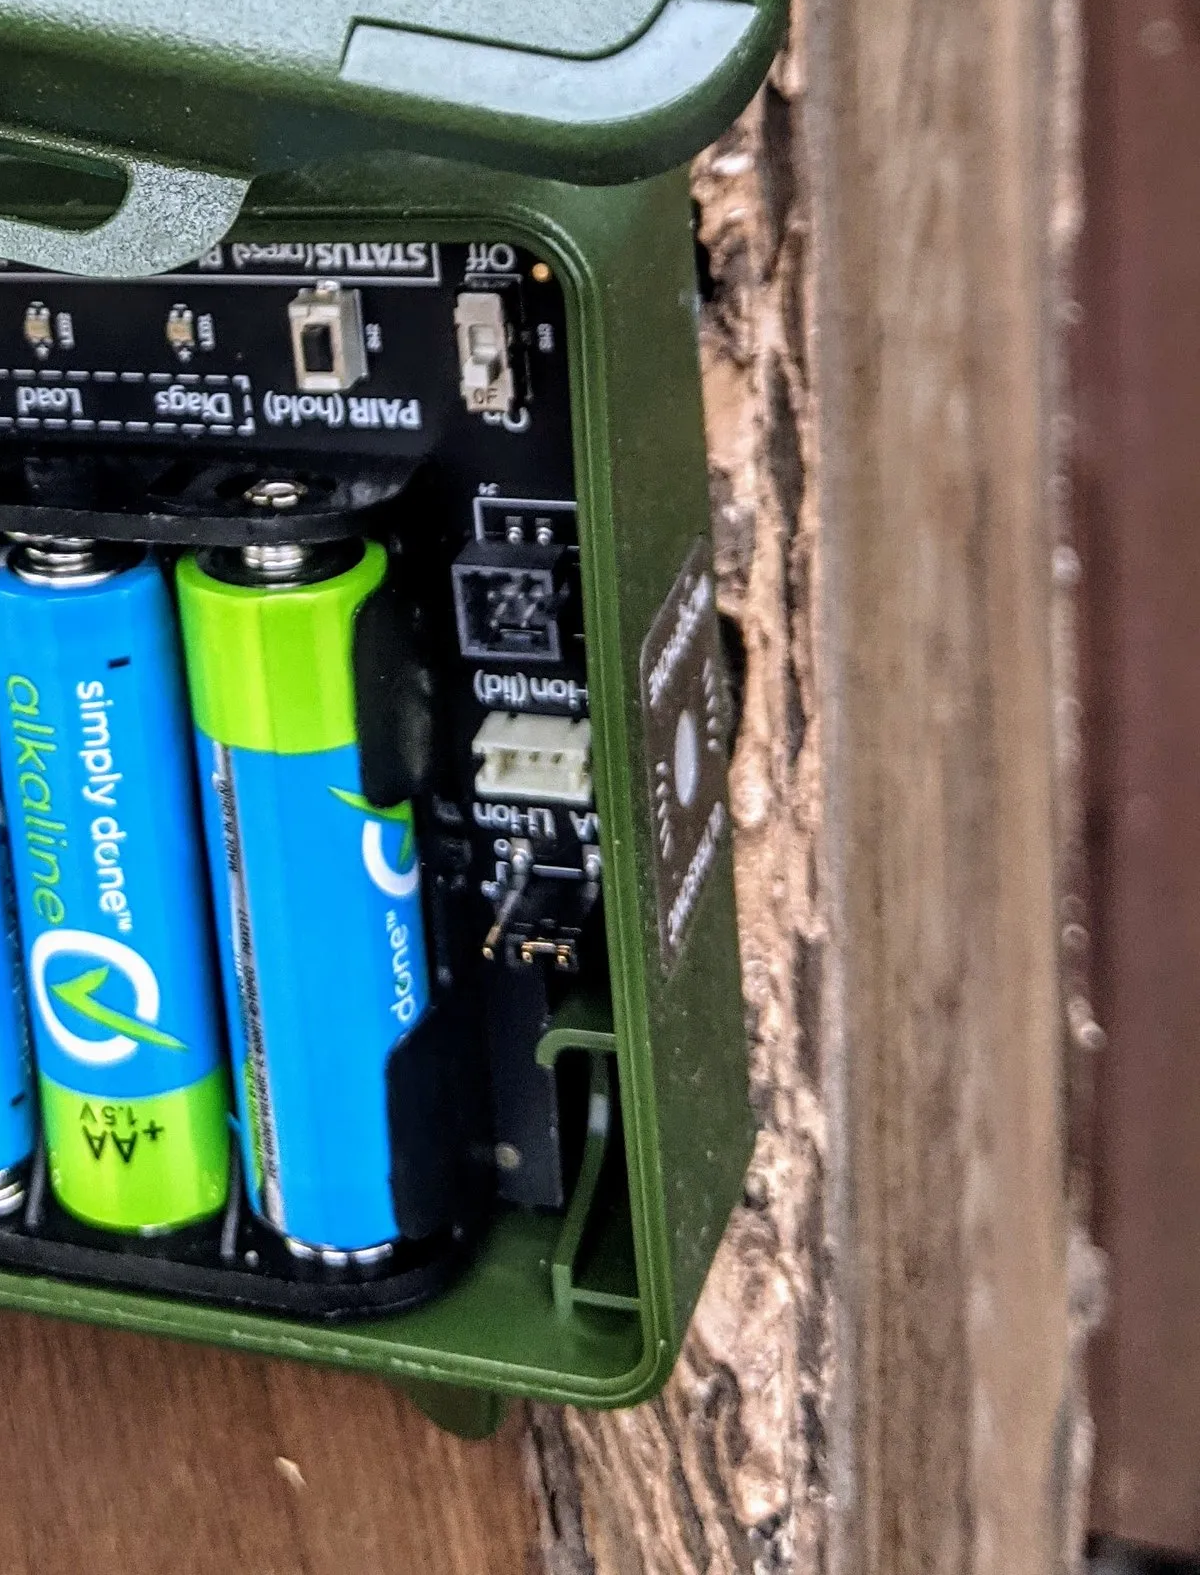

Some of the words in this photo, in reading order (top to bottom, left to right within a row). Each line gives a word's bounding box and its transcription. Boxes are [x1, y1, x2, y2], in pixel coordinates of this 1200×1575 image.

[465, 243, 517, 272] Off
[15, 385, 85, 417] Load
[154, 386, 234, 421] Diags
[263, 390, 345, 426] (hold)
[349, 396, 423, 431] PAIR
[473, 669, 531, 708] (lid)
[76, 680, 124, 806] simply
[6, 673, 68, 926] alkaline
[472, 801, 558, 840] Li-ion
[79, 1101, 138, 1127] 1.5V
